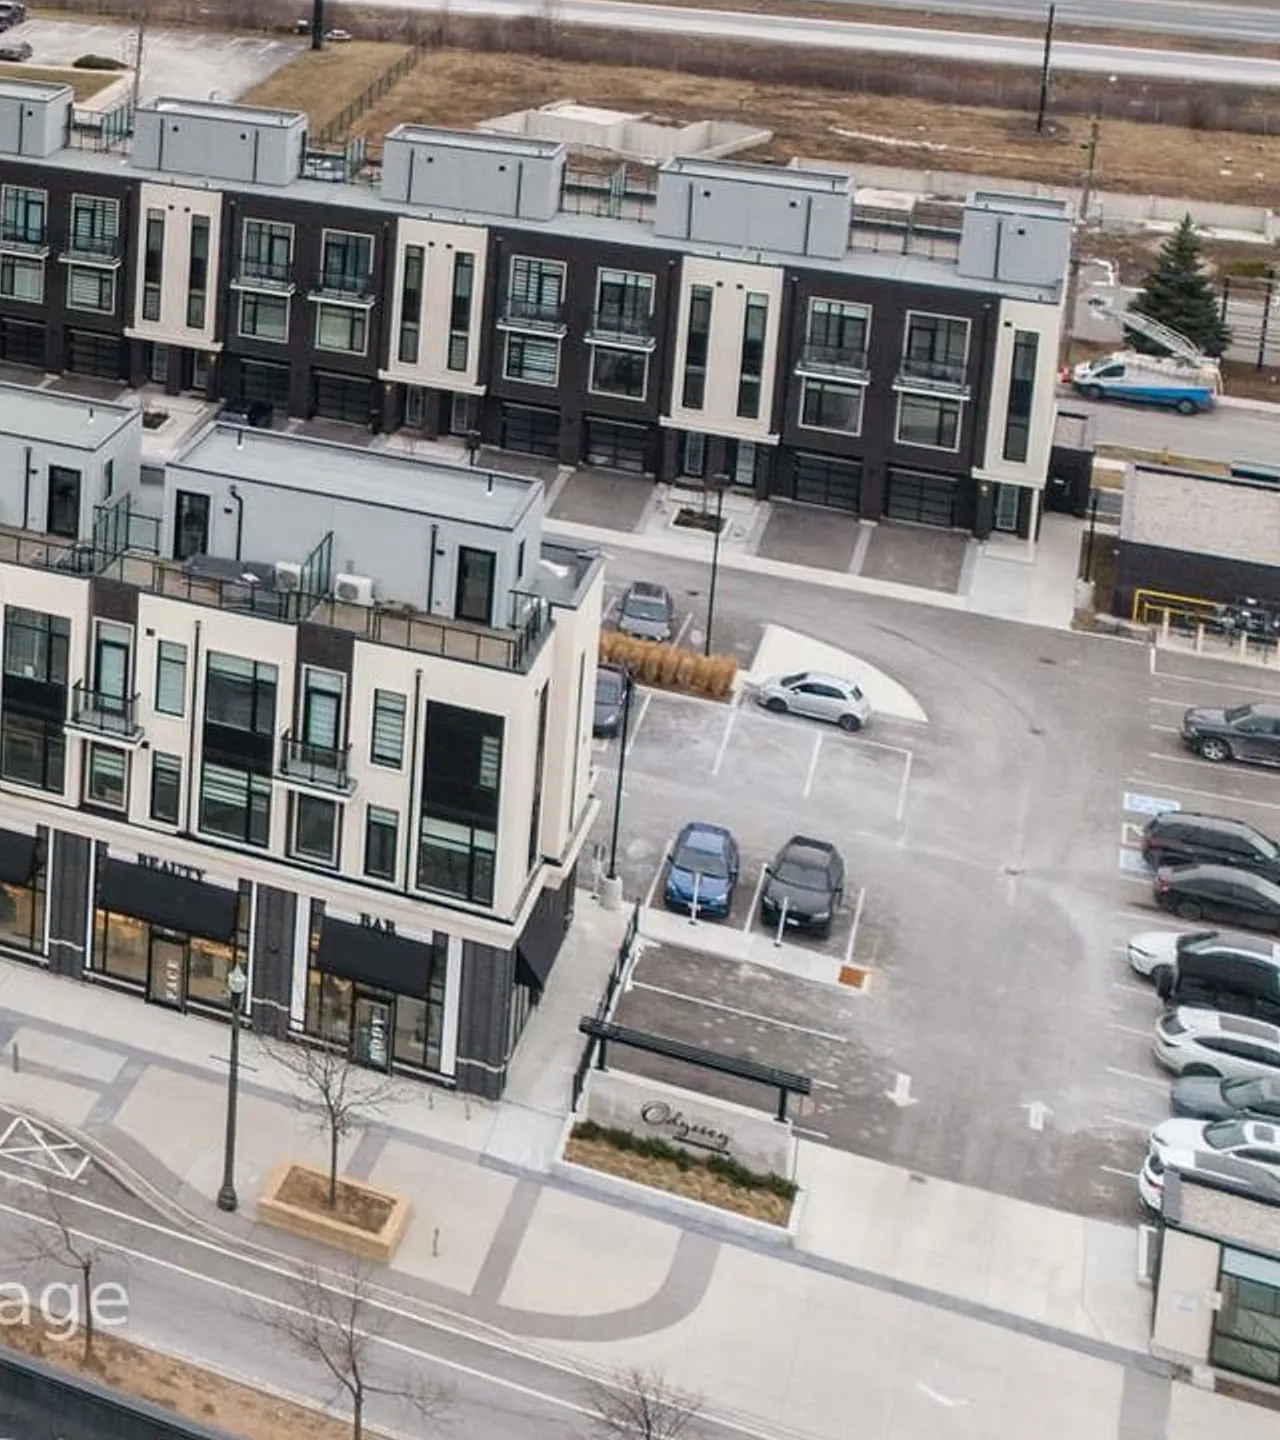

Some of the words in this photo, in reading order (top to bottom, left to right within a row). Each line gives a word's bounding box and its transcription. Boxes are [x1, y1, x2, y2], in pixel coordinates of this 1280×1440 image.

[138, 852, 206, 881] BEAUTY
[360, 912, 397, 936] BAR
[165, 960, 180, 1000] FACE
[641, 1100, 729, 1150] Odyssey
